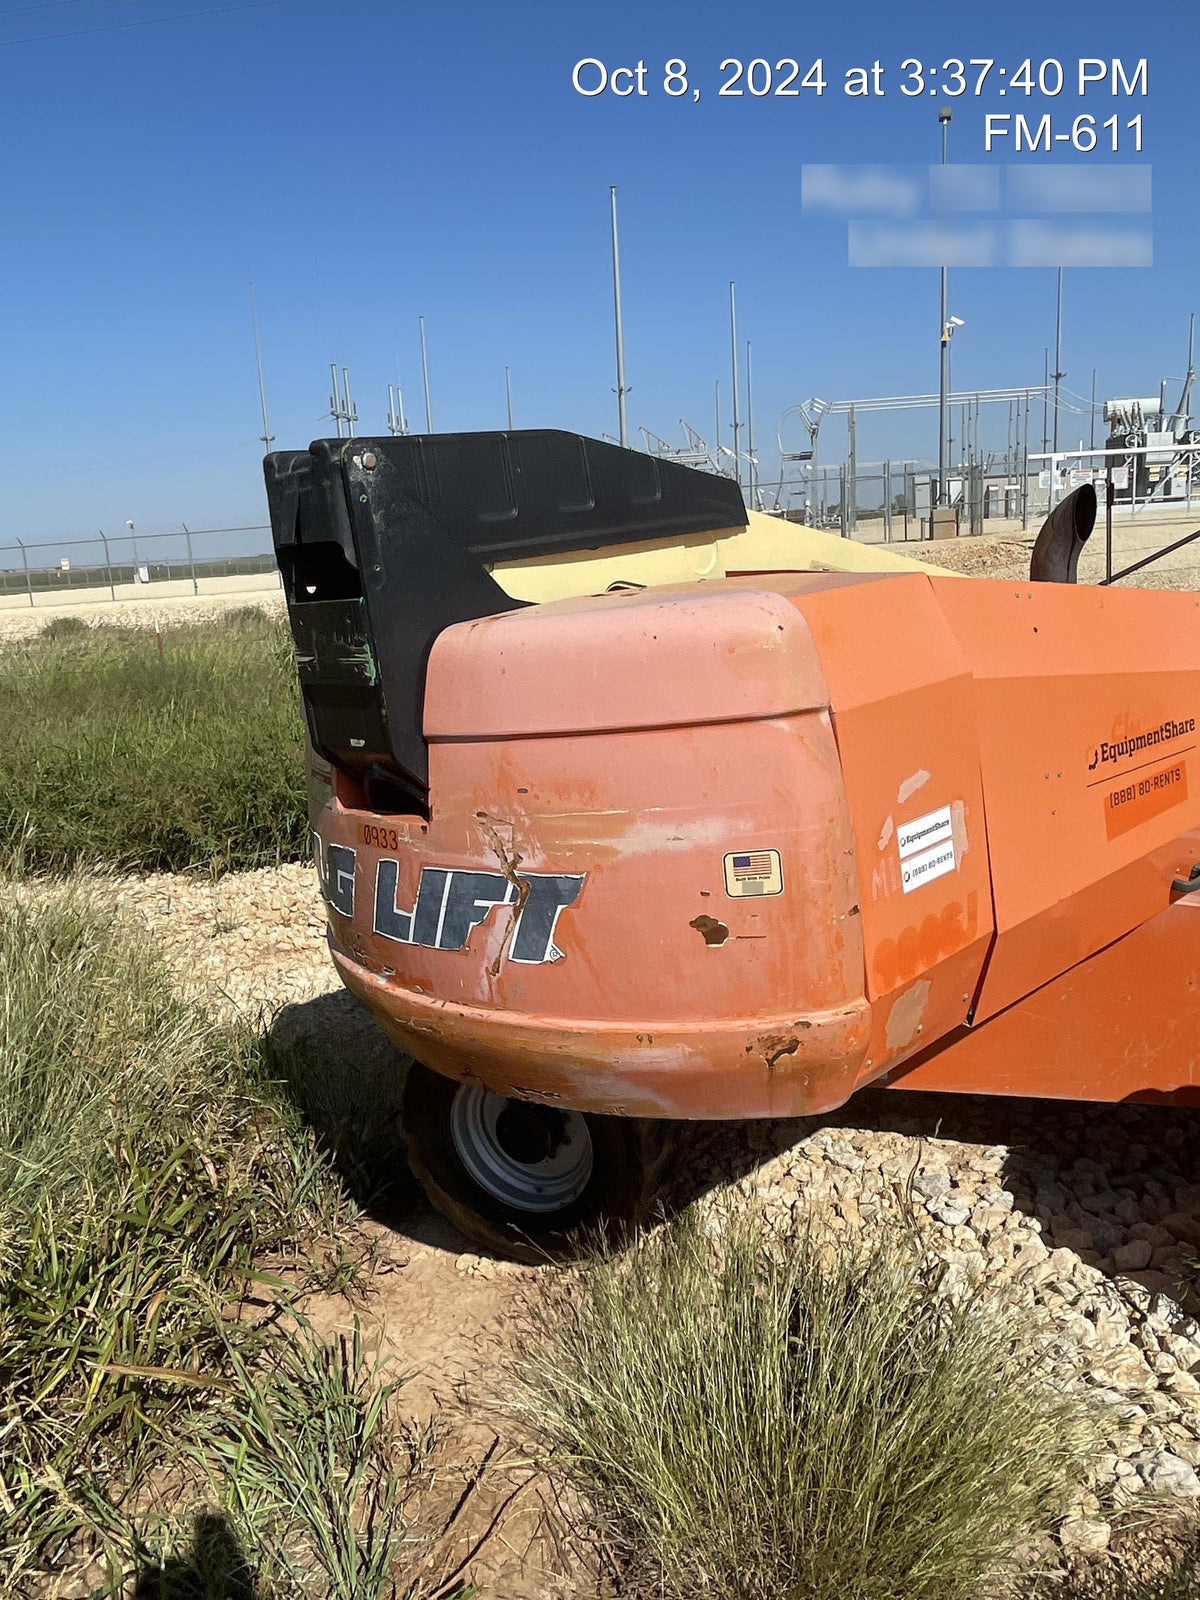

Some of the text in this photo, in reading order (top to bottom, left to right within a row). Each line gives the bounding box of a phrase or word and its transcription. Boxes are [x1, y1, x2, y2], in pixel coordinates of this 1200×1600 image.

[1100, 718, 1196, 763] EquipmentShare
[1109, 768, 1181, 808] (888) 80-RENTS
[363, 824, 399, 851] 0933
[373, 857, 587, 964] LIFT
